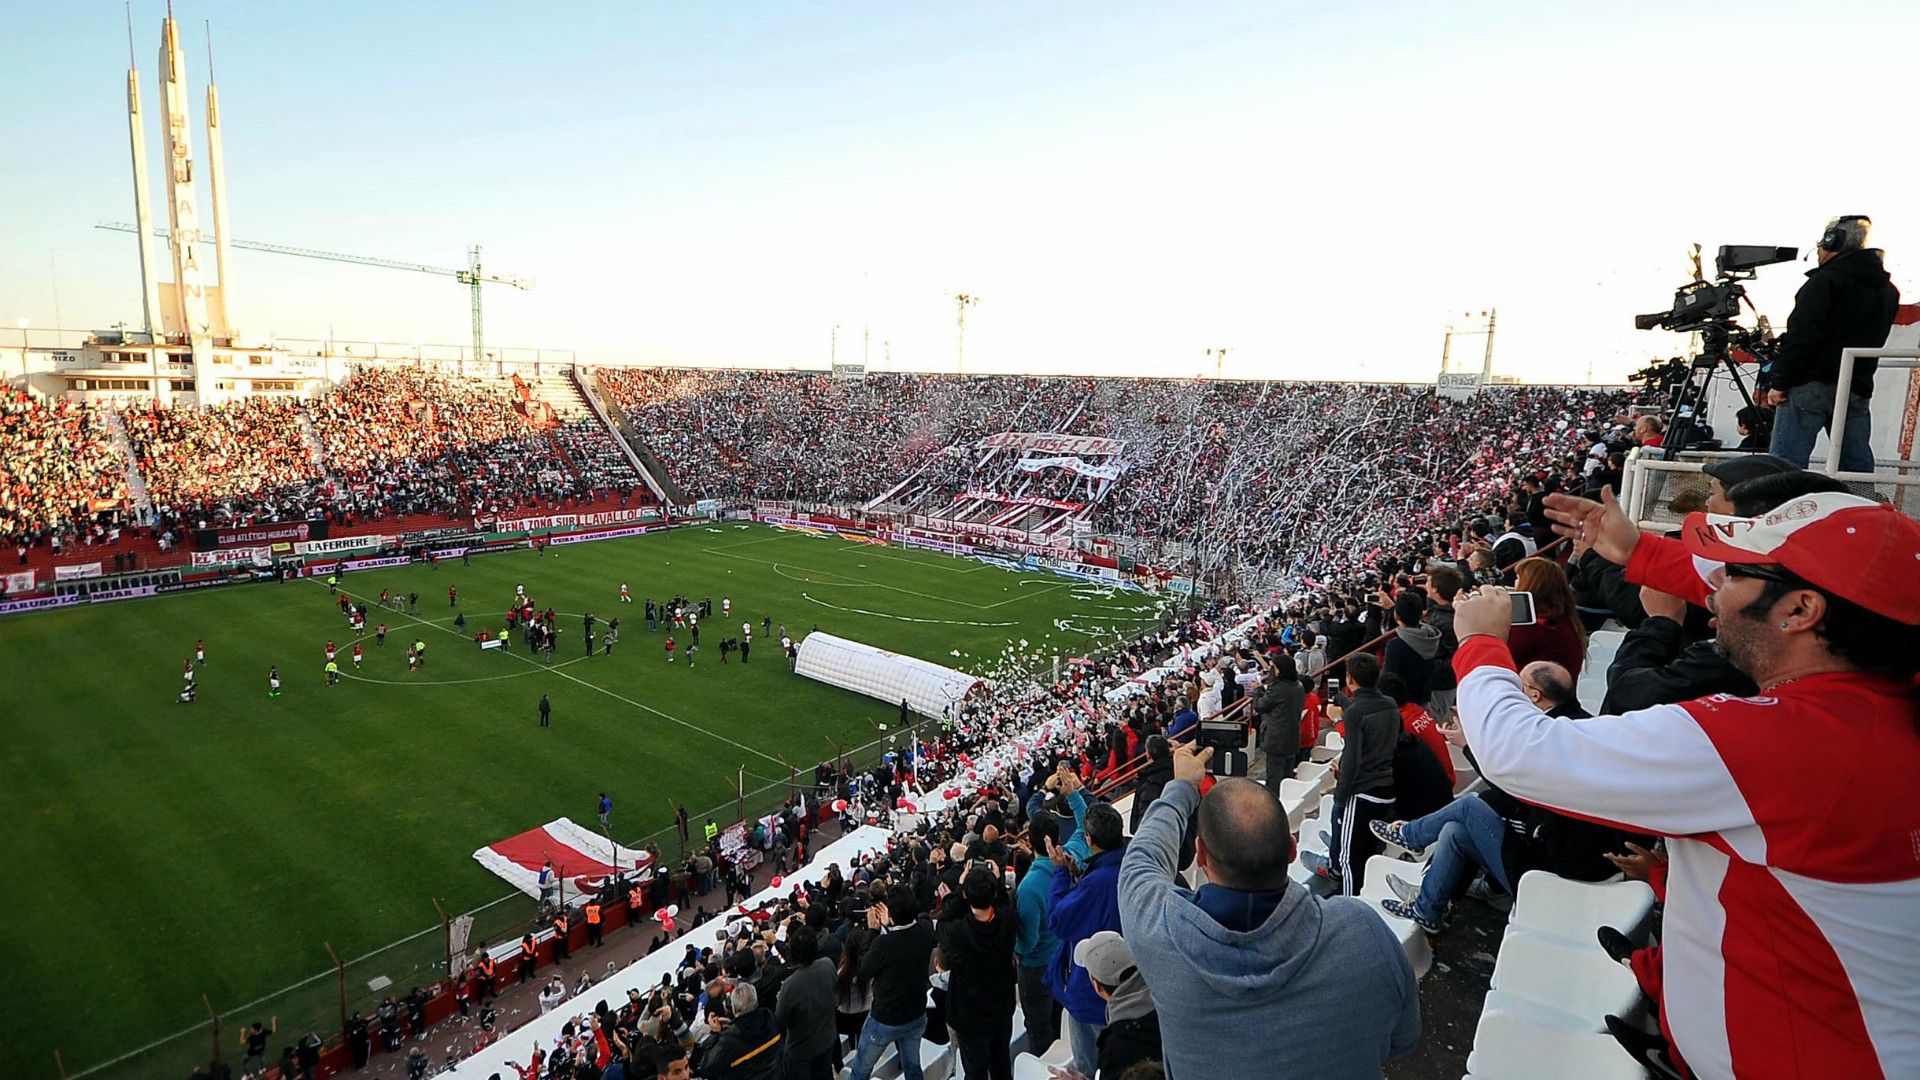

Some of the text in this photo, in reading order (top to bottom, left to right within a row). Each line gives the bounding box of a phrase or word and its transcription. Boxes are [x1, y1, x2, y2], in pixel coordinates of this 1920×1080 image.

[656, 505, 690, 518] SENZ
[529, 518, 552, 530] ZONA
[555, 517, 575, 527] SUR
[577, 510, 641, 526] LLAVALLOL
[218, 534, 236, 544] CLUB
[308, 537, 369, 552] LAFERRERE
[357, 558, 398, 568] CARUSO
[0, 598, 60, 612] CARUSO
